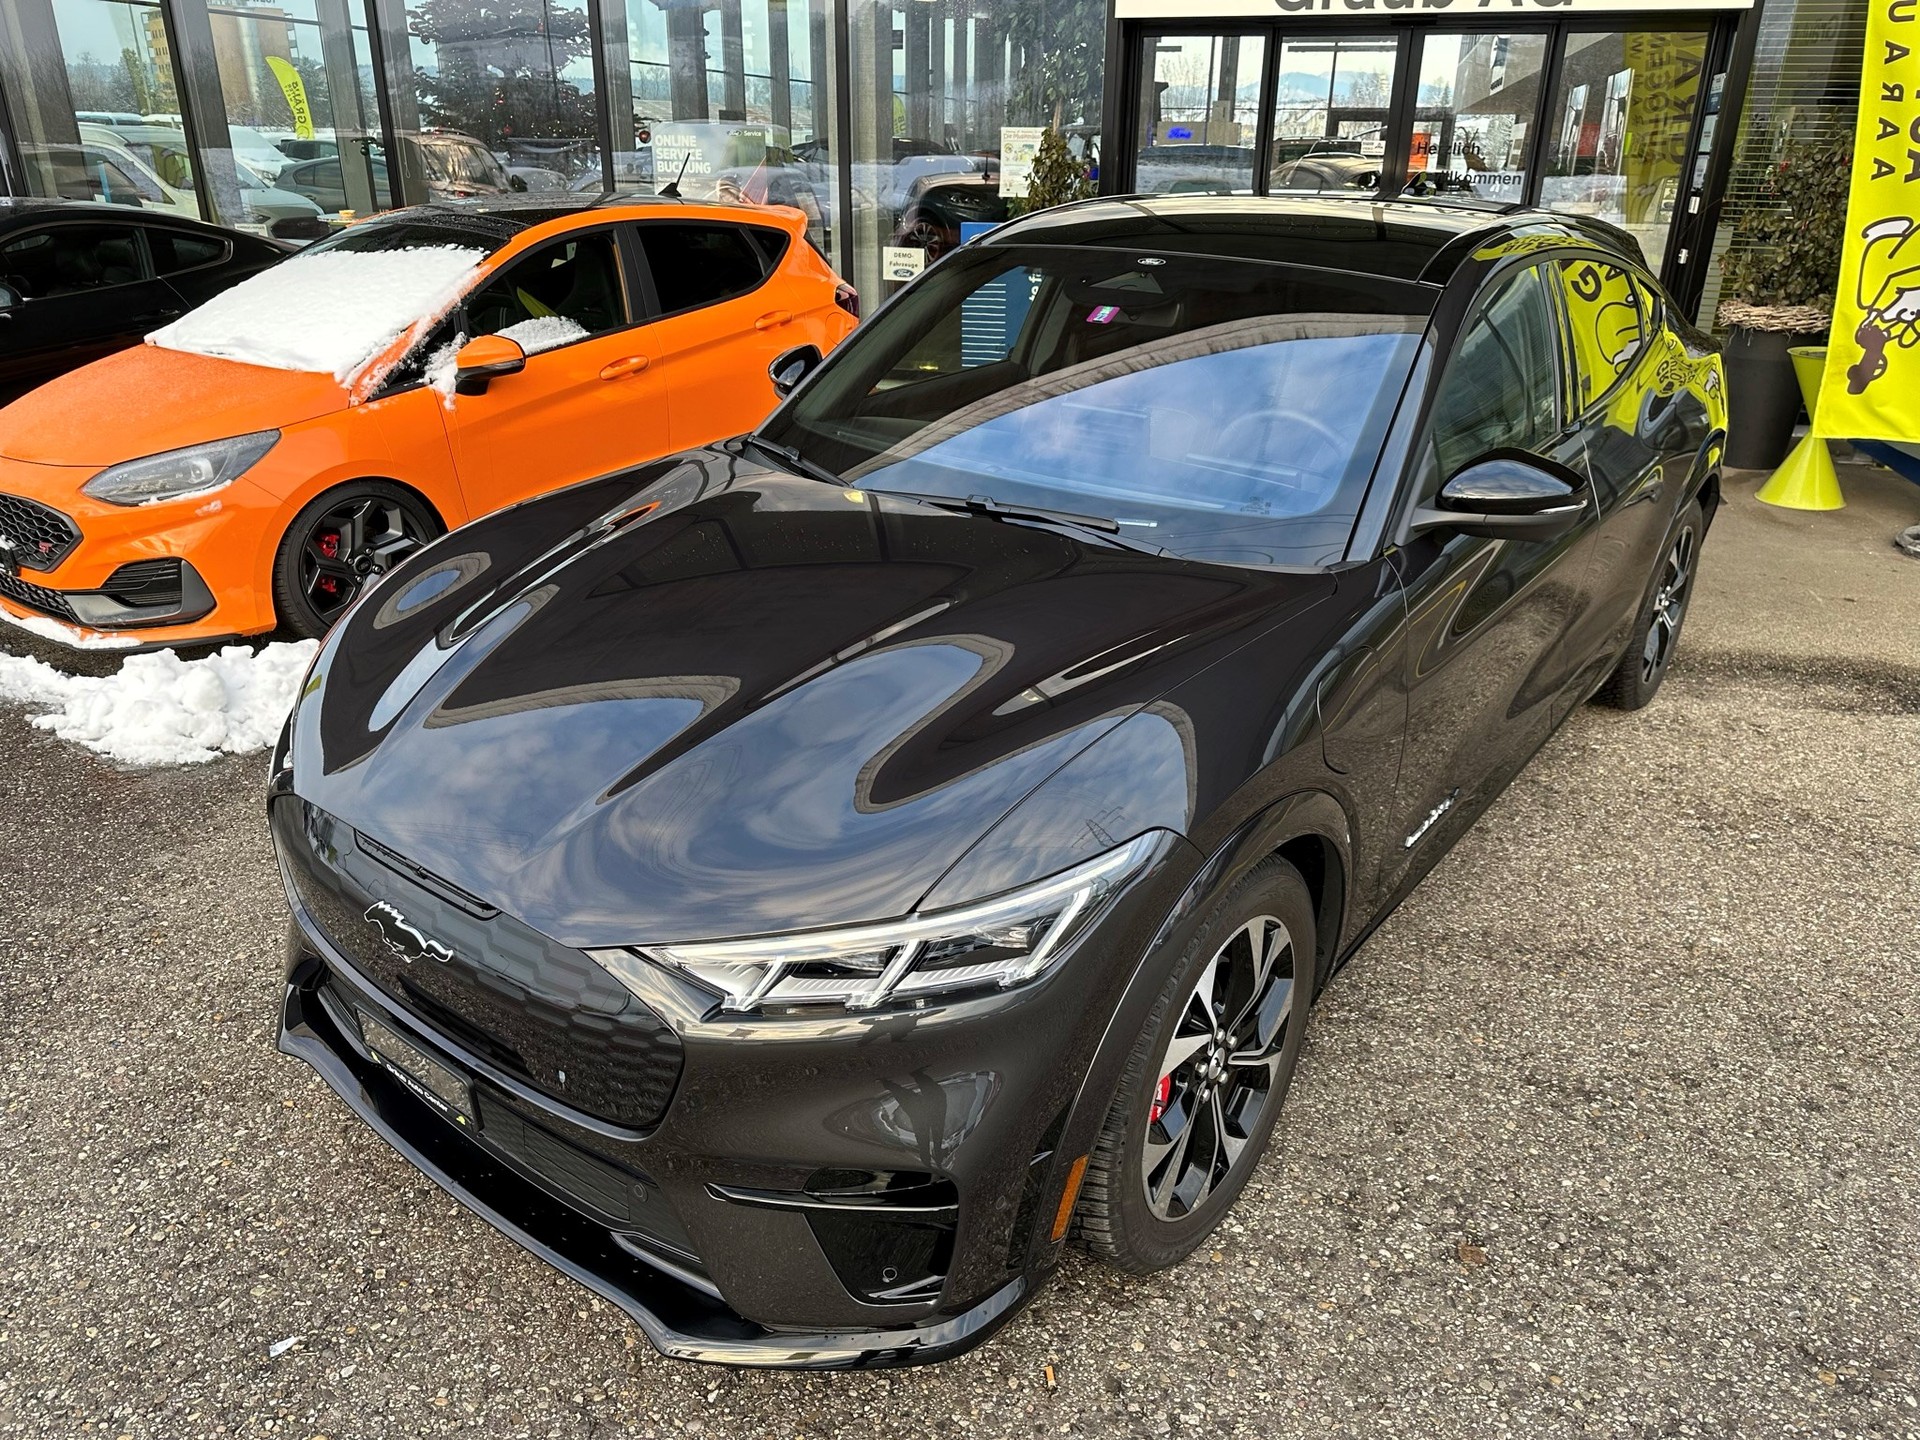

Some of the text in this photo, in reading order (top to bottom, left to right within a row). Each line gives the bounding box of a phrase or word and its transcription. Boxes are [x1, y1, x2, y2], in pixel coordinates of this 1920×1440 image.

[655, 134, 697, 147] ONLINE
[656, 147, 703, 160] SERVICE
[889, 260, 918, 269] Fahrzeuge
[39, 541, 53, 553] ST
[408, 1080, 423, 1095] Auto
[424, 1091, 448, 1112] Center
